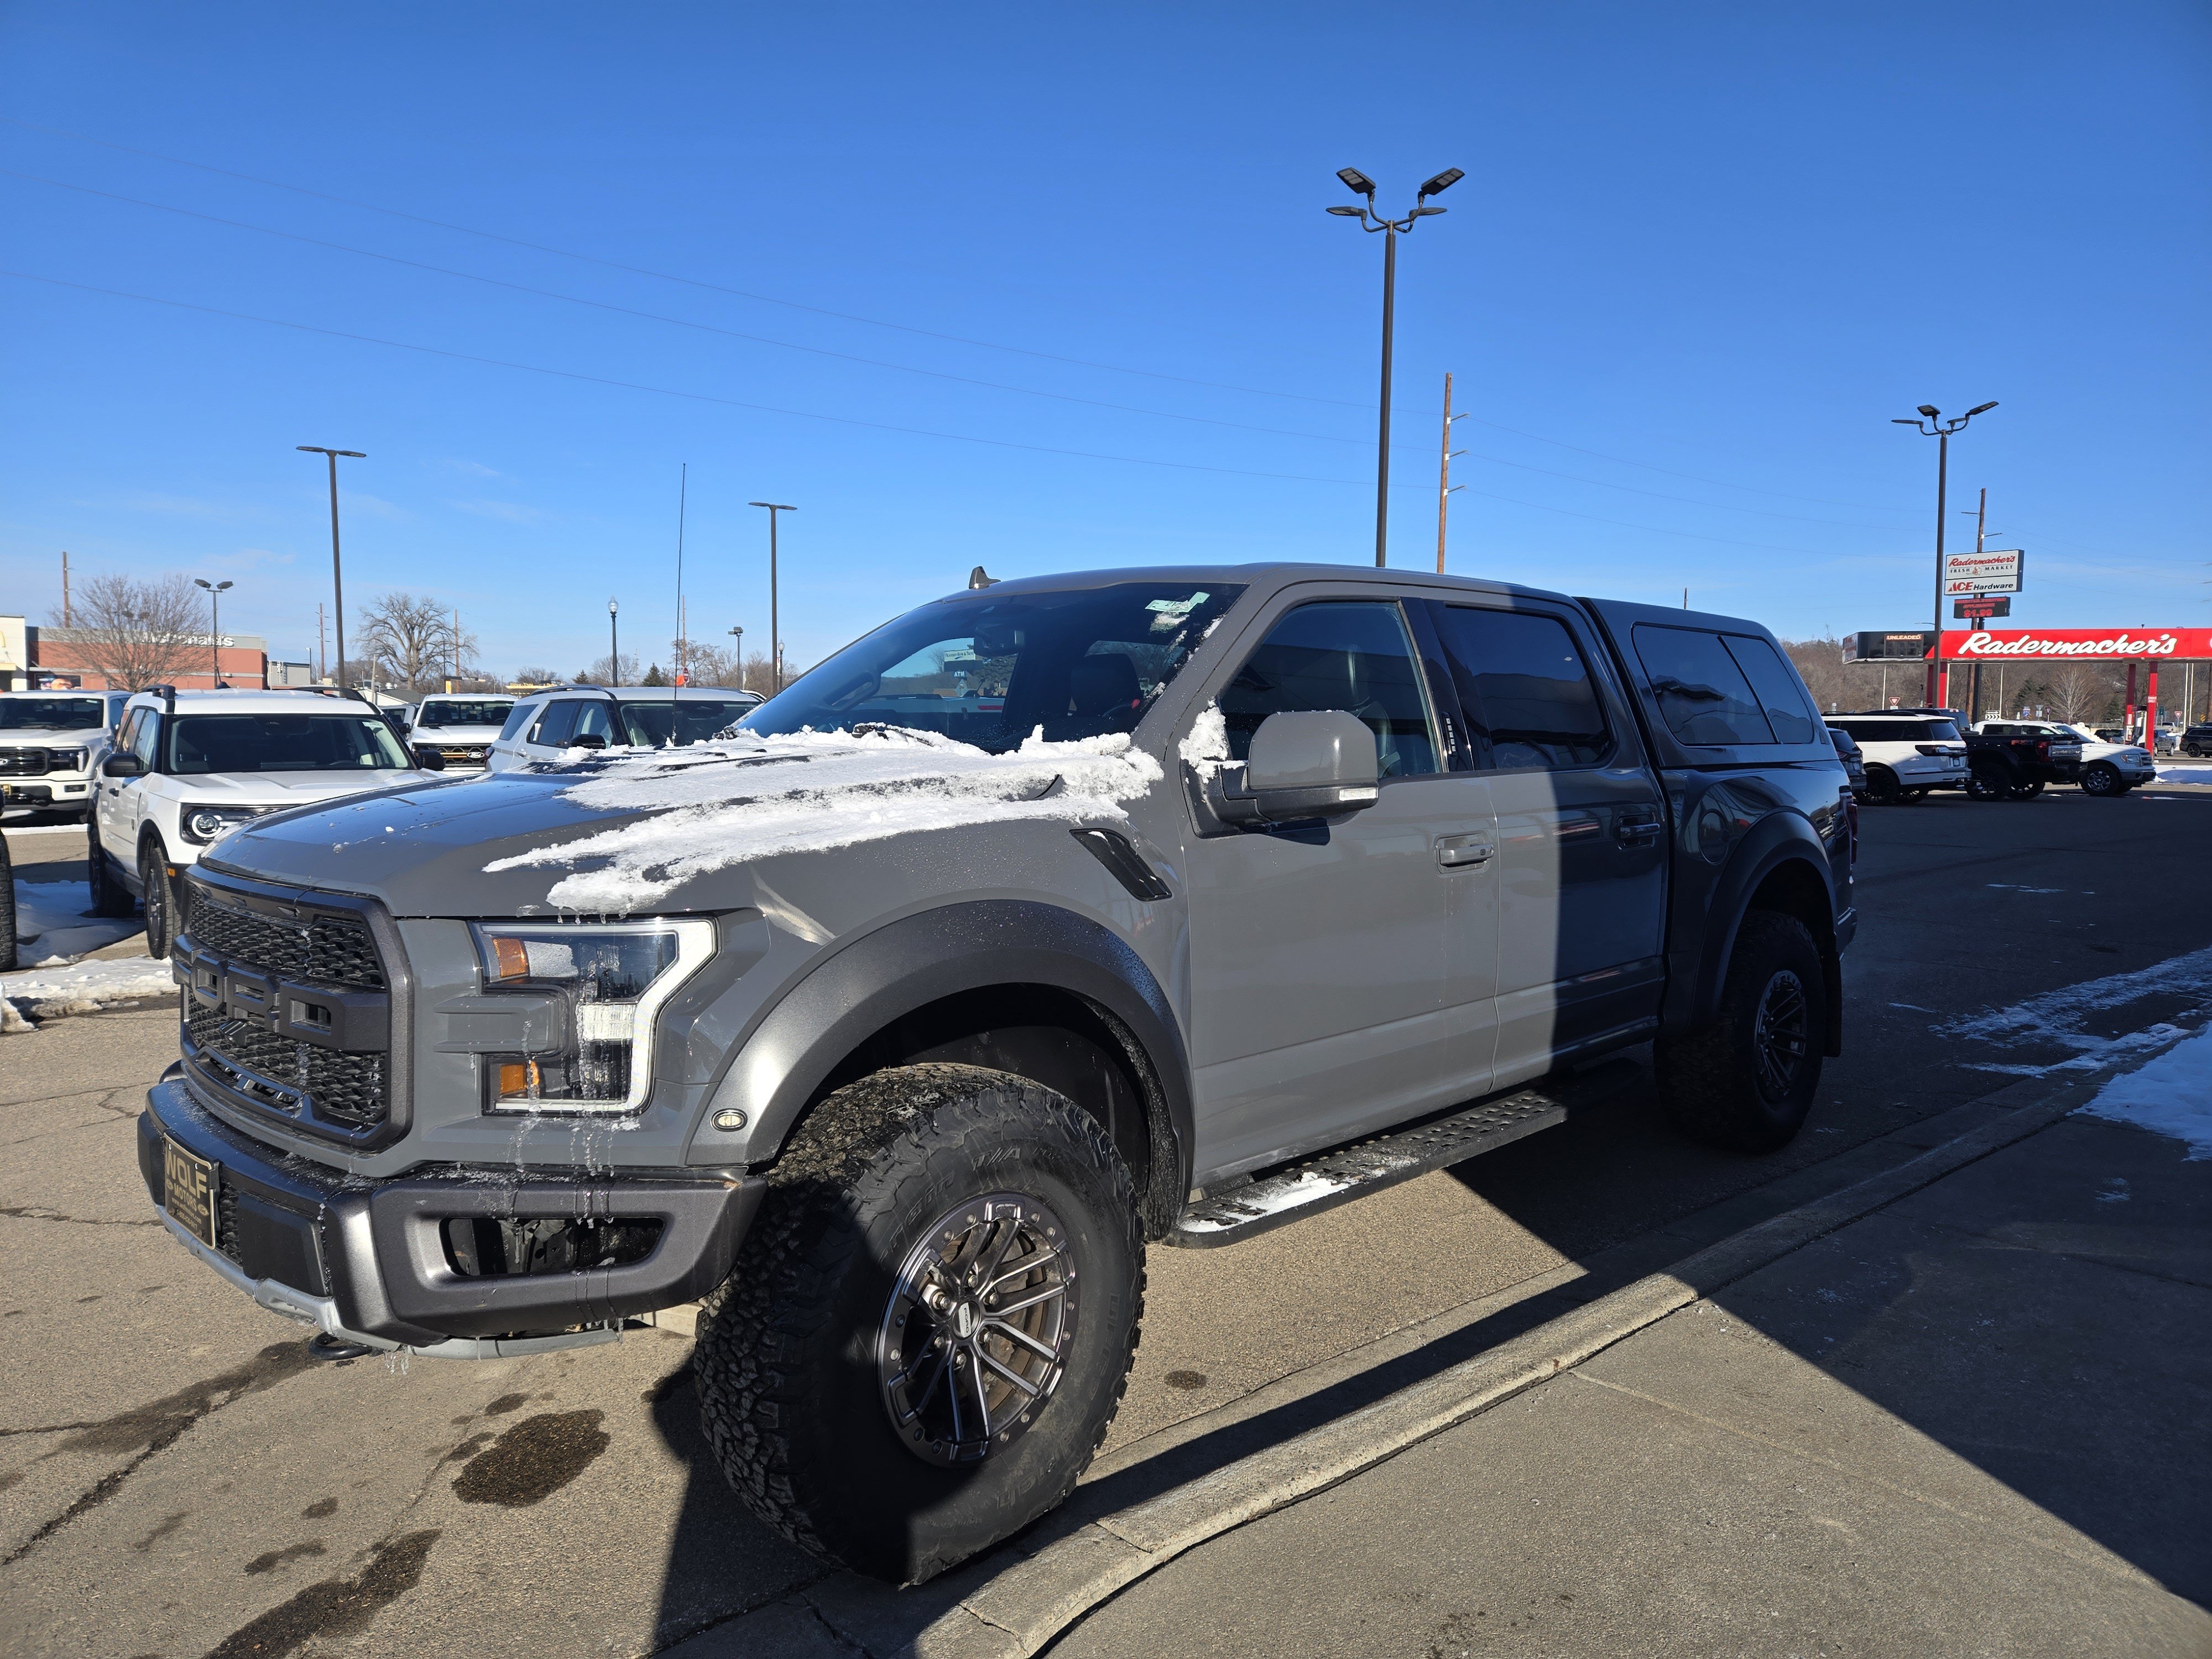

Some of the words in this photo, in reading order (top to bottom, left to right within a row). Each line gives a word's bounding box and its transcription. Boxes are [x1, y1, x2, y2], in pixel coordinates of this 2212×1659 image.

[1949, 555, 2016, 567] Radermacher's
[1948, 581, 1974, 592] ACE
[1958, 632, 2177, 655] Radermacher's
[166, 1150, 207, 1199] WOLF
[173, 1183, 197, 1212] MOTORS
